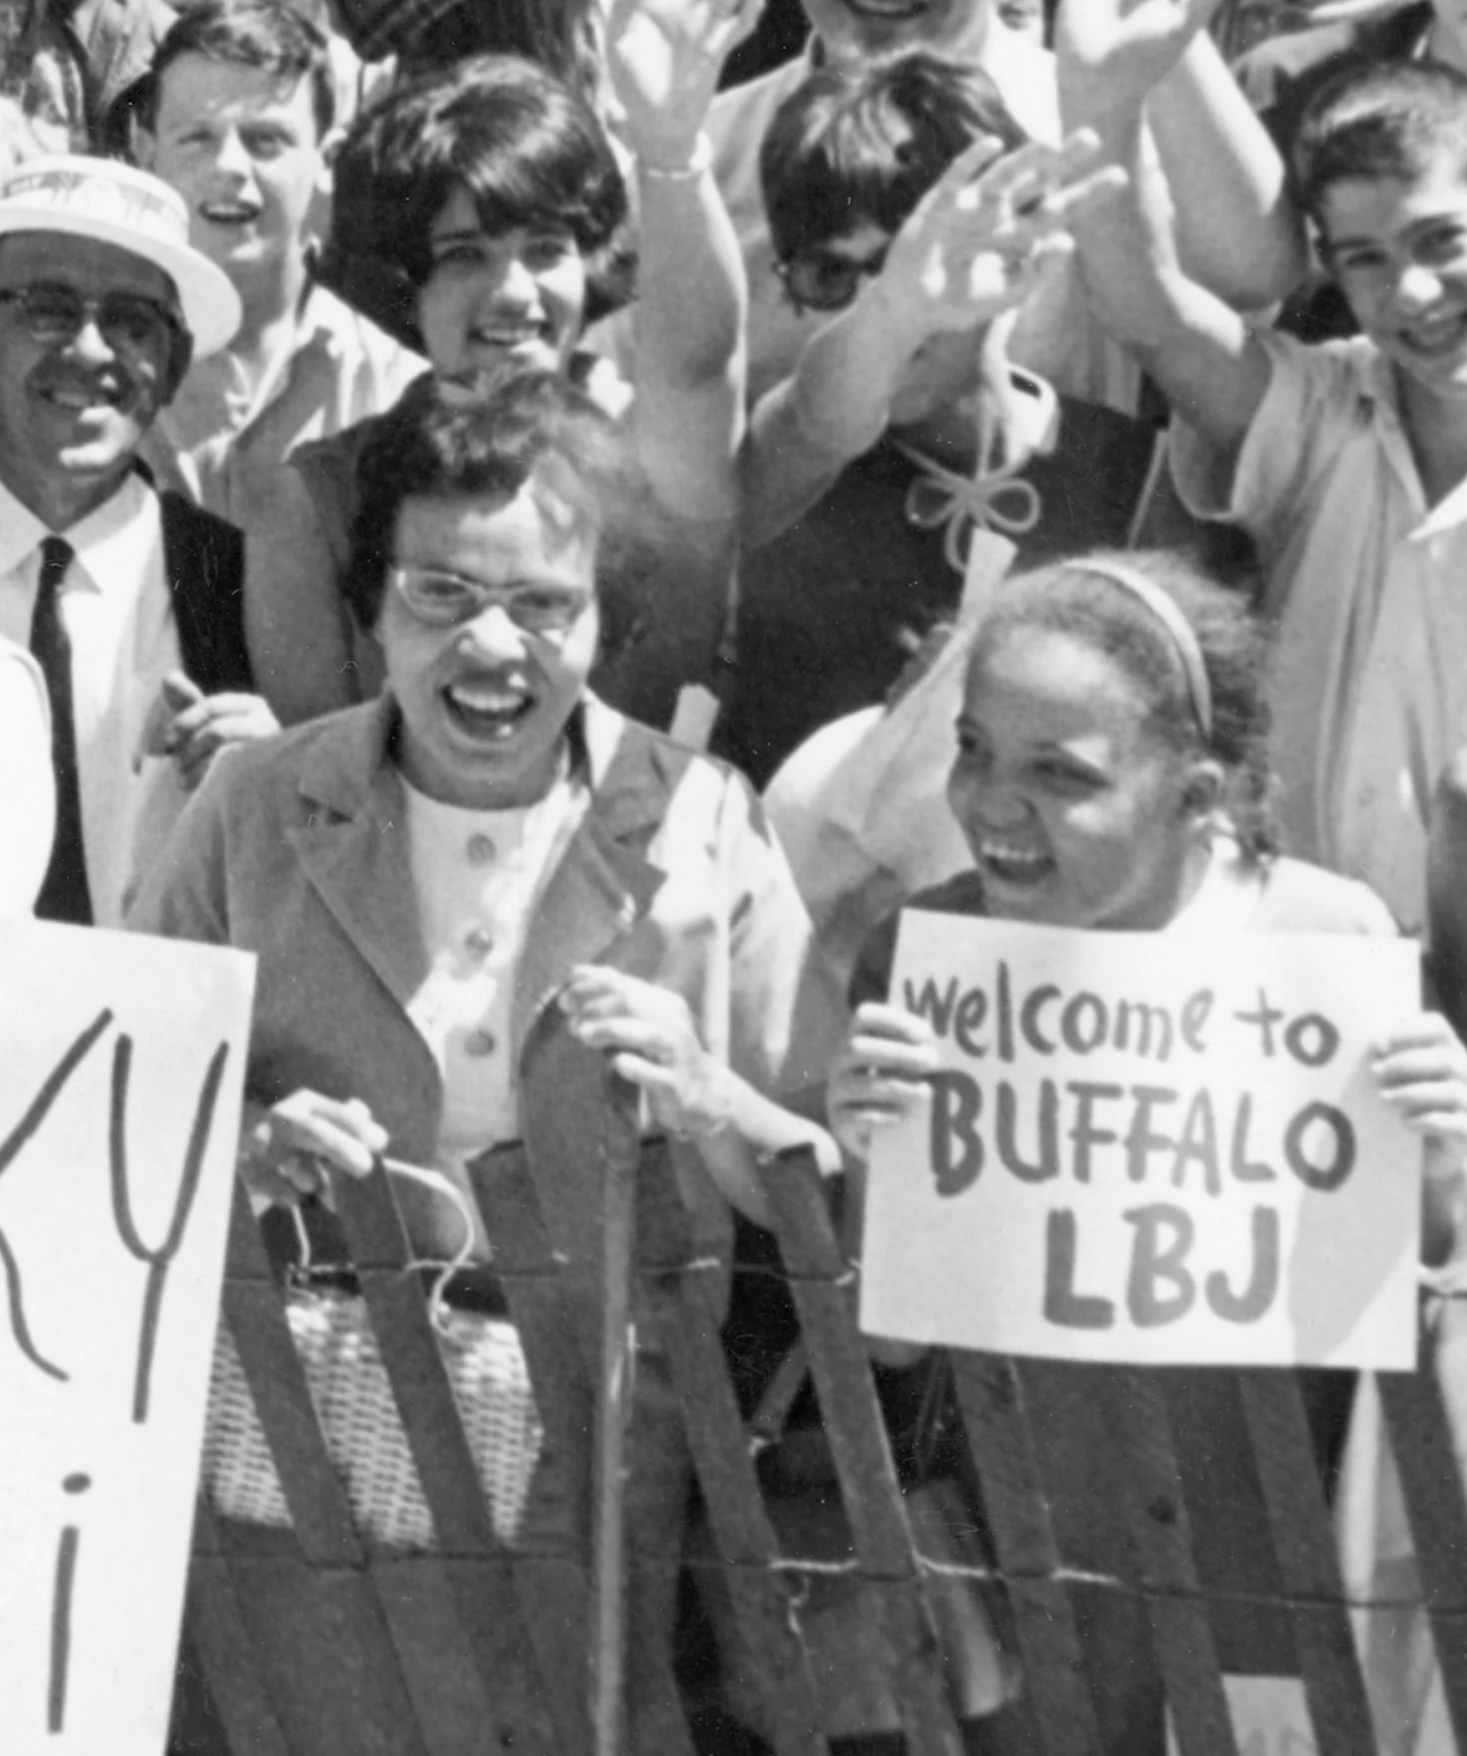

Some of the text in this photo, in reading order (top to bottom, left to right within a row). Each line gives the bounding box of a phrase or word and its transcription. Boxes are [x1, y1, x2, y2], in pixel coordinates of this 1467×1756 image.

[1233, 987, 1341, 1067] to
[931, 1068, 1357, 1198] BUFFALO
[1042, 1203, 1279, 1330] LBJ
